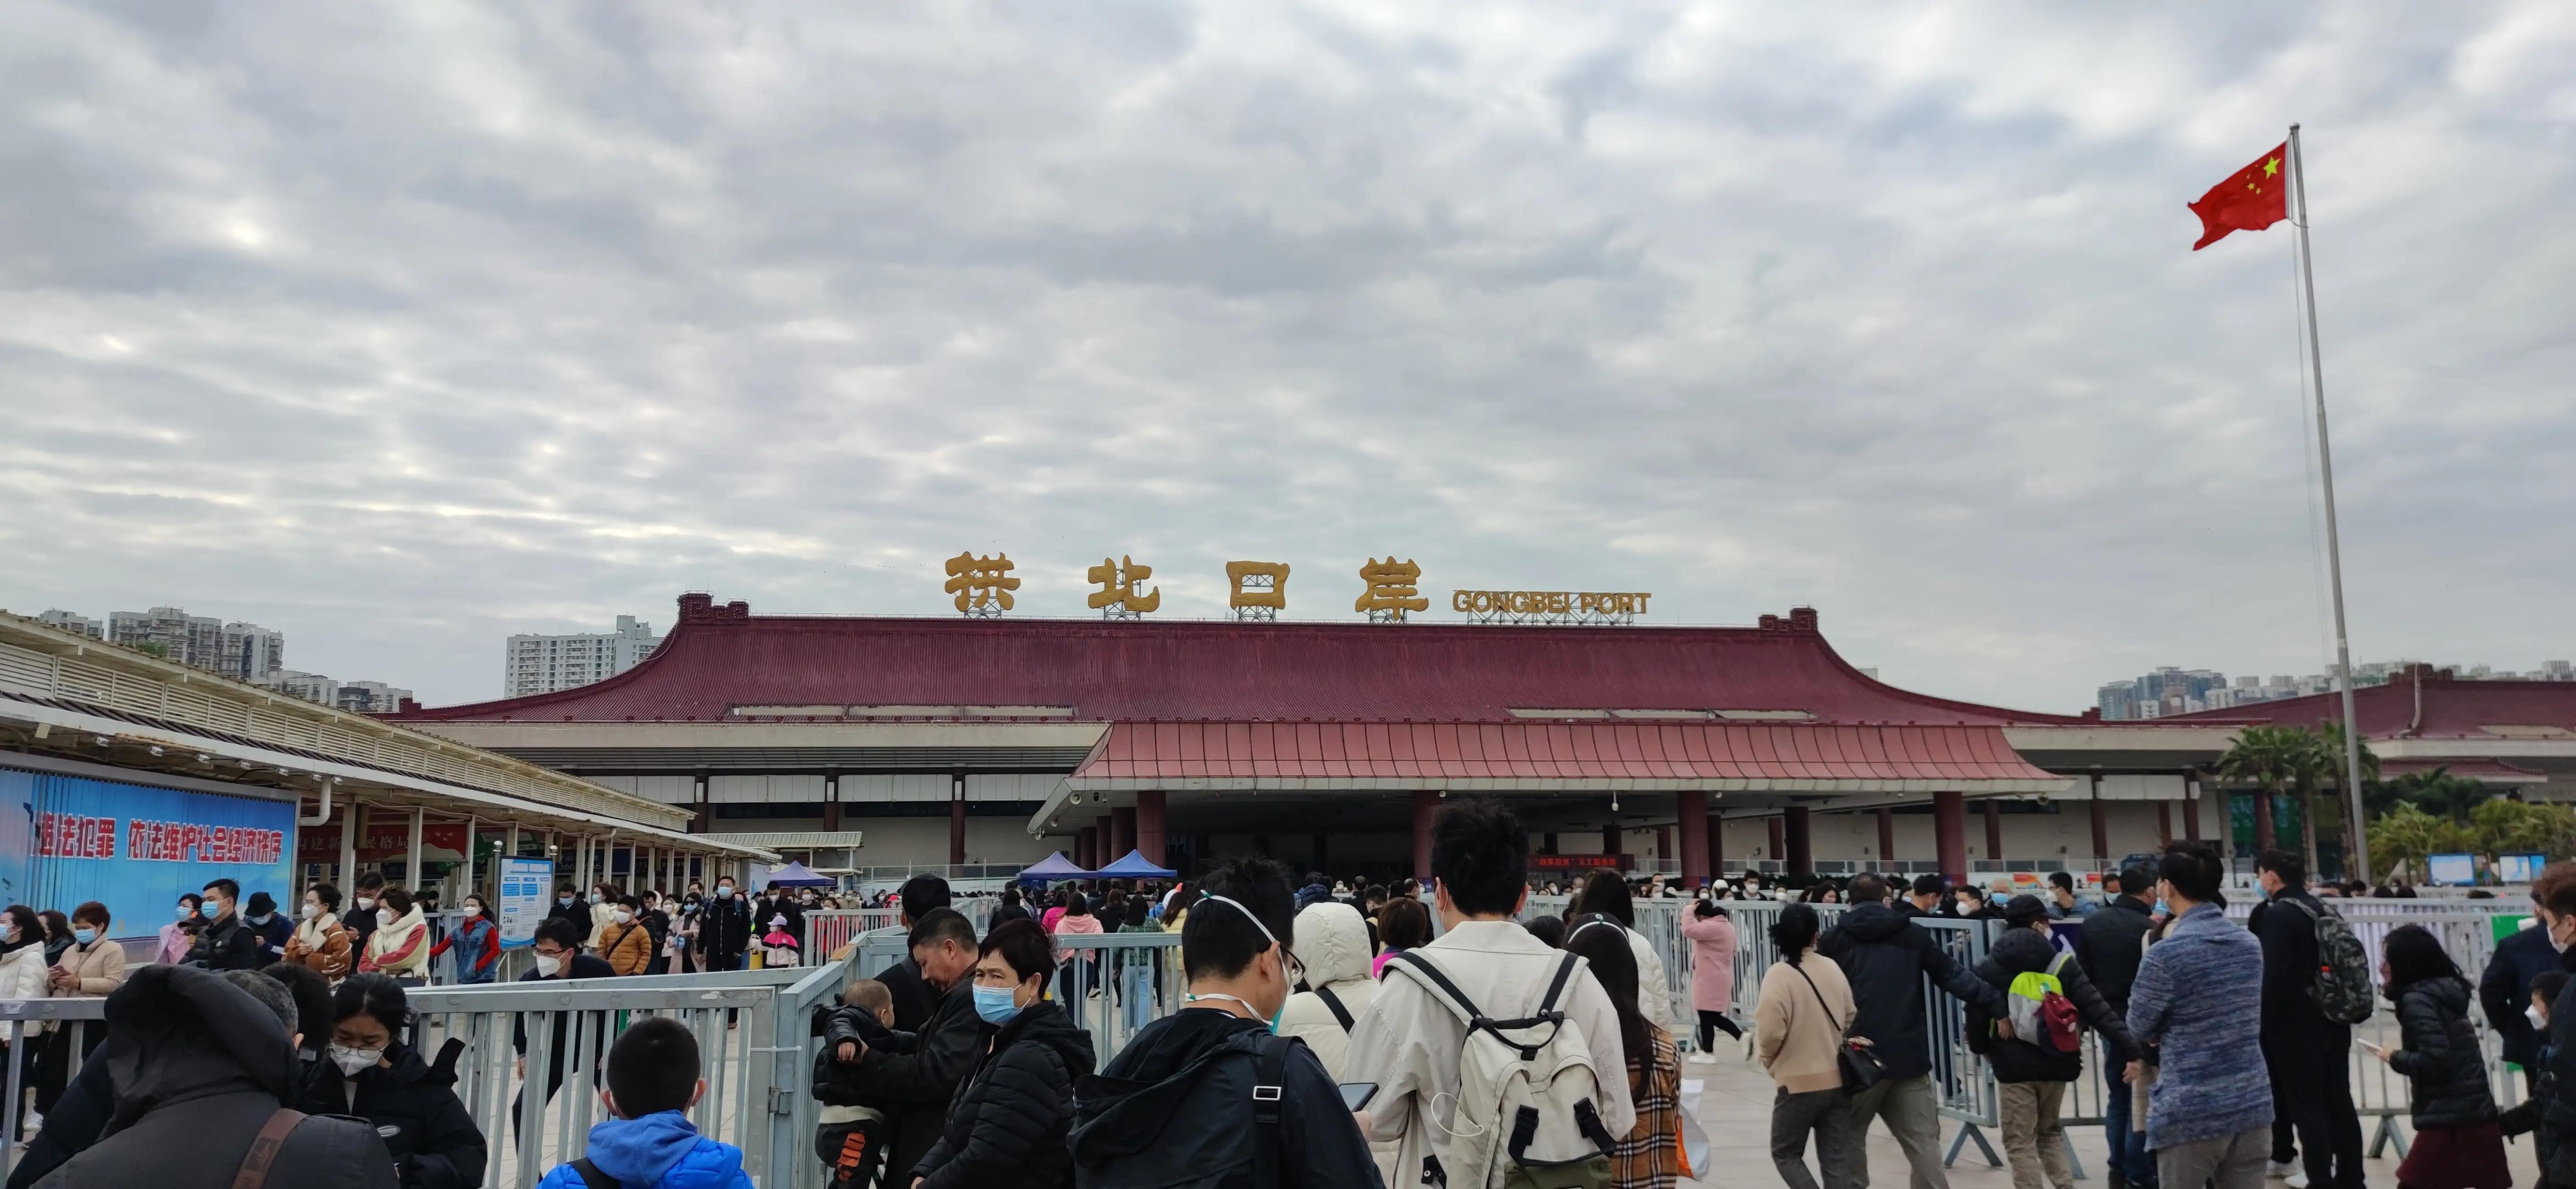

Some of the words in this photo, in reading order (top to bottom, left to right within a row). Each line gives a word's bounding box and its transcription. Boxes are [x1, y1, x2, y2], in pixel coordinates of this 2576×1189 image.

[945, 551, 1428, 619] 拱北口岸
[1453, 590, 1570, 613] GONGBEI
[1579, 592, 1651, 614] PORT
[127, 818, 283, 865] 依法维护社会经济秩序
